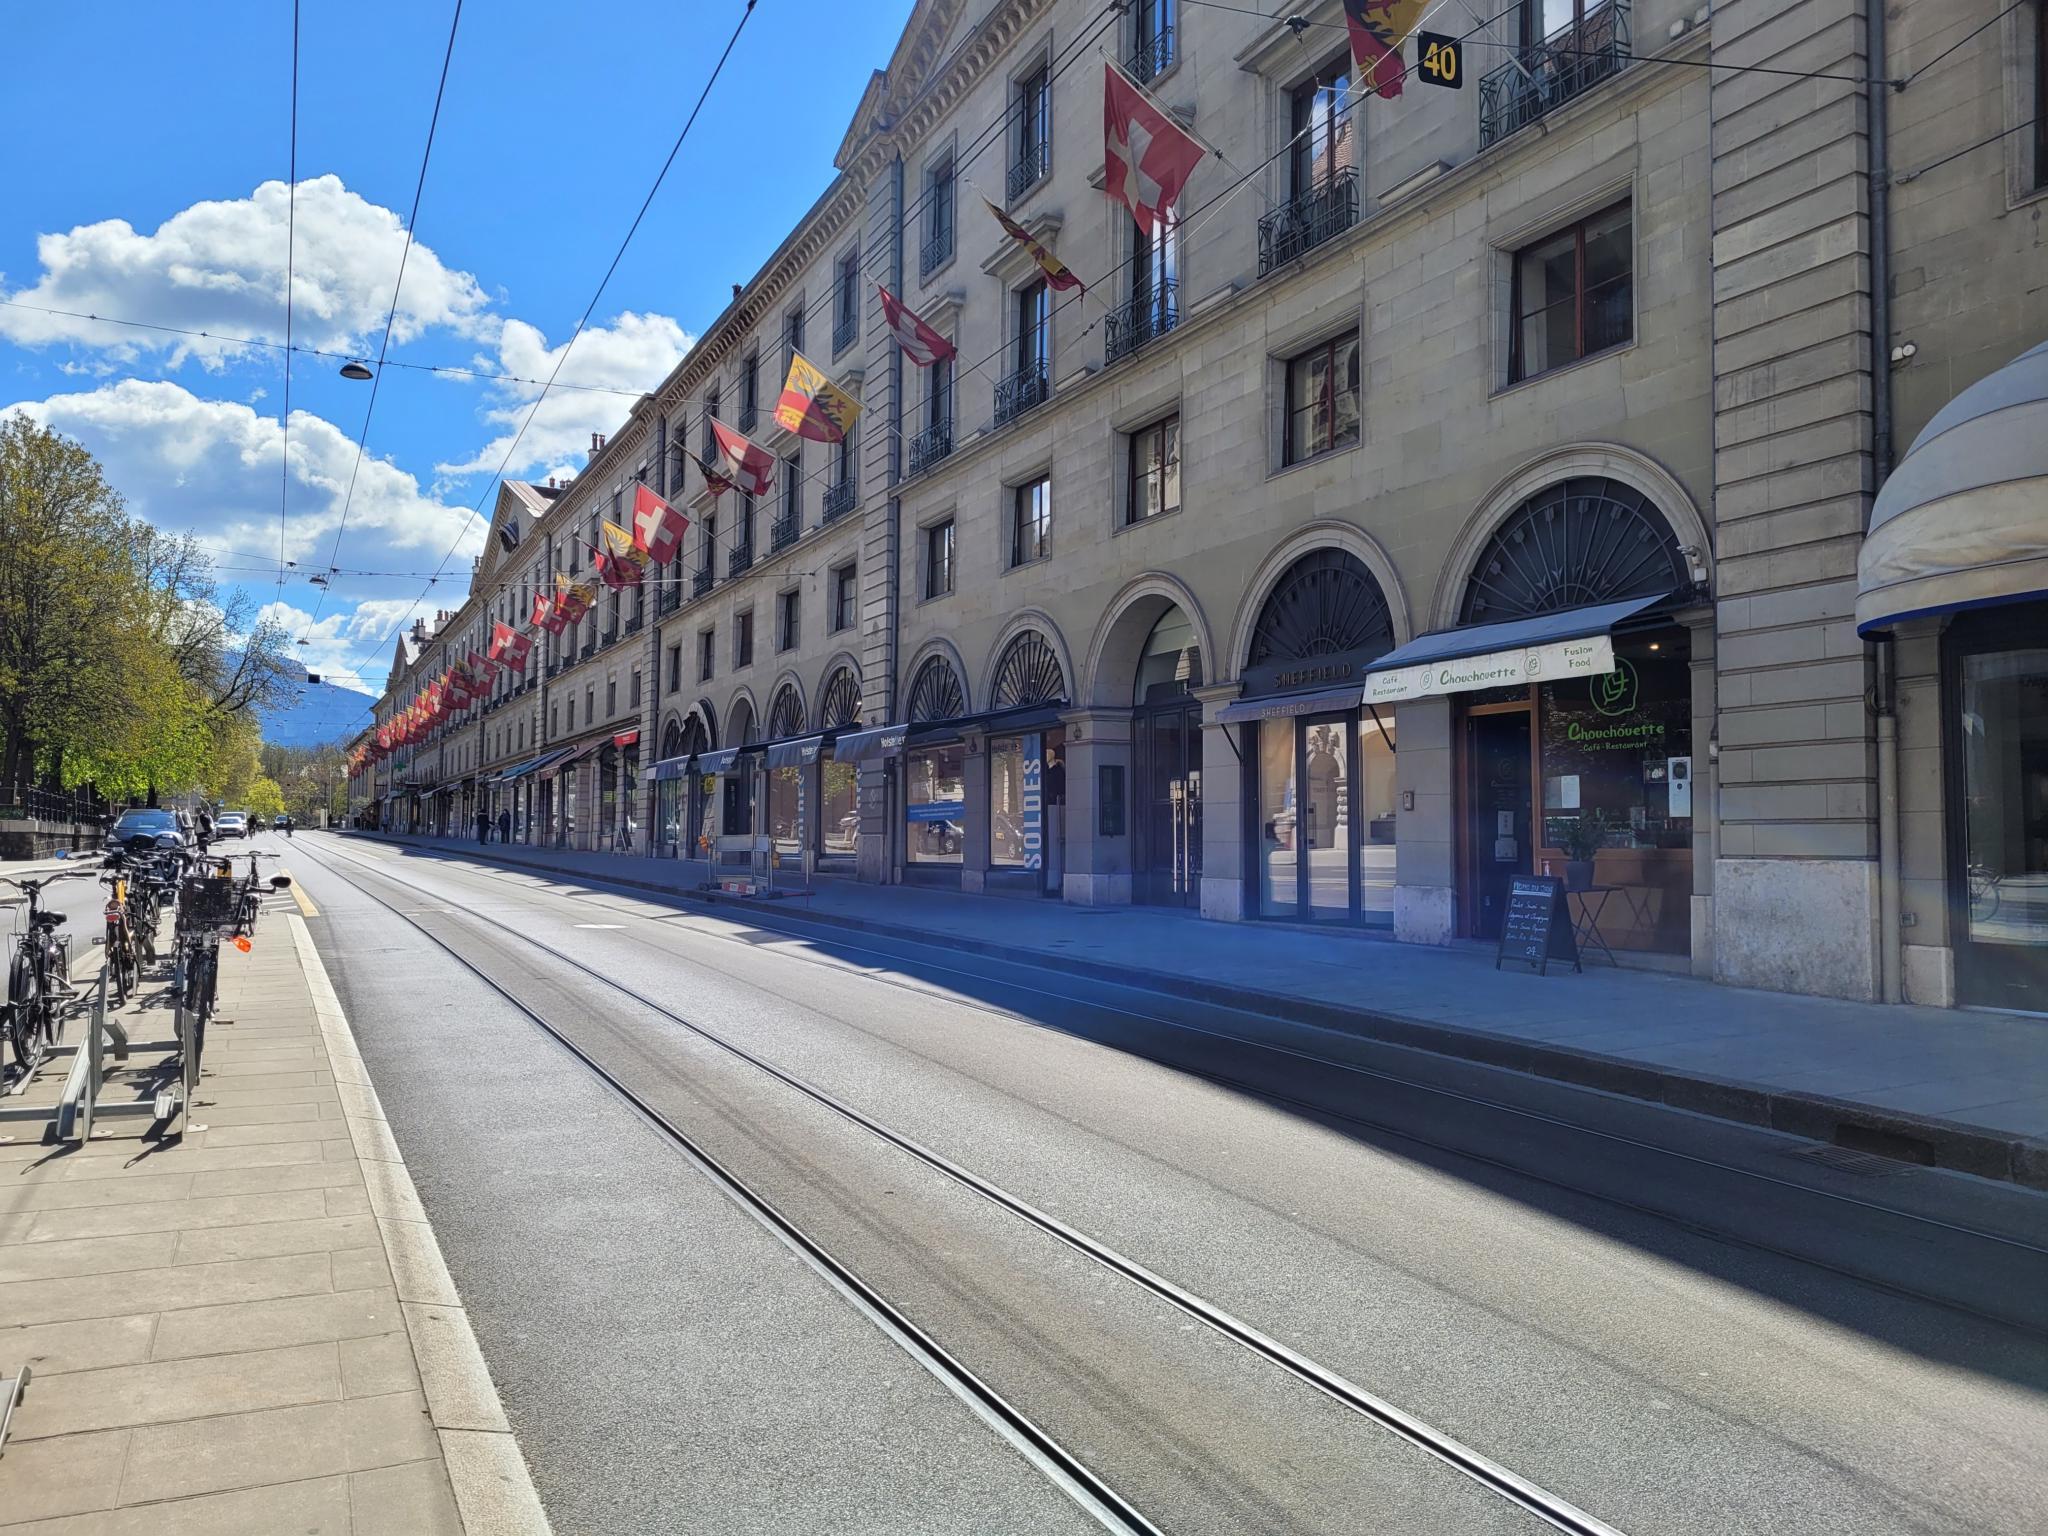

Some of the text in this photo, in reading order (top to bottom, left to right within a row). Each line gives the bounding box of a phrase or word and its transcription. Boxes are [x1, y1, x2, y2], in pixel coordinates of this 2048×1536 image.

[1424, 42, 1456, 80] 40
[1564, 646, 1593, 656] Fusion
[1568, 657, 1591, 668] Food
[1273, 663, 1351, 688] SHEFFIELD
[1382, 675, 1398, 685] Café
[1440, 667, 1517, 686] Chouchouette
[1372, 686, 1408, 696] Restaurant
[1261, 703, 1305, 718] SHEFFIELD
[1567, 722, 1665, 740] Chouchouette
[1023, 758, 1042, 869] SOLDES
